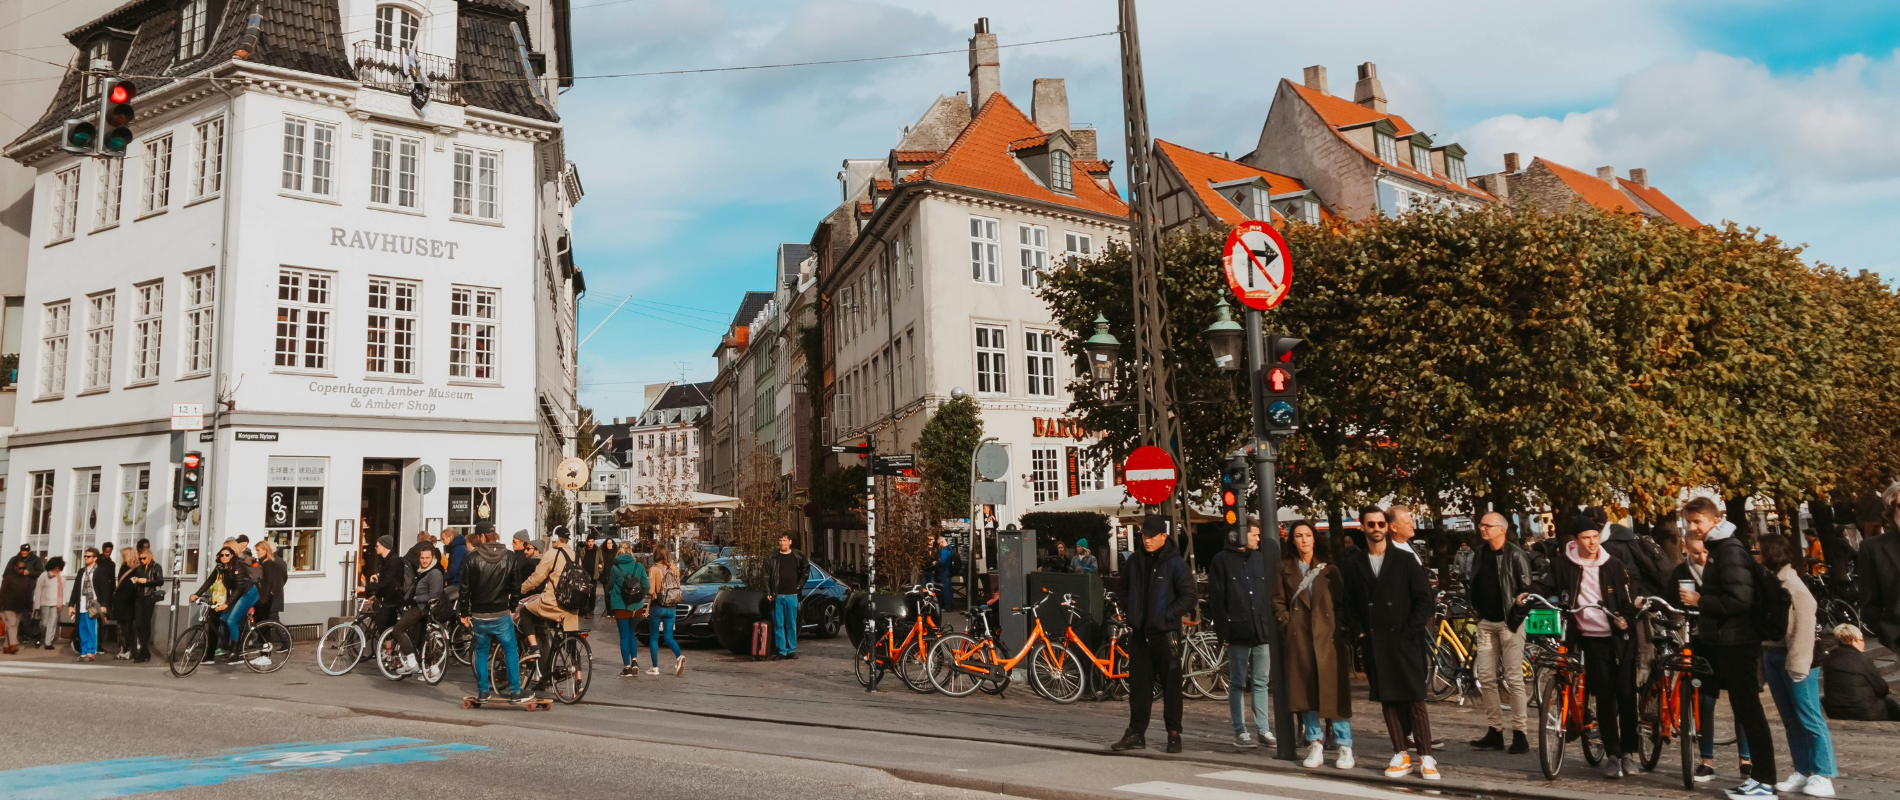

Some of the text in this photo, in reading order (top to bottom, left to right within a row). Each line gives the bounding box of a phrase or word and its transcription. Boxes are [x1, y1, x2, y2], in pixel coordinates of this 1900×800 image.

[329, 226, 459, 260] RAVHUSET
[308, 381, 474, 400] Copenhagen Amber Museum
[350, 397, 436, 413] & Amber Shop
